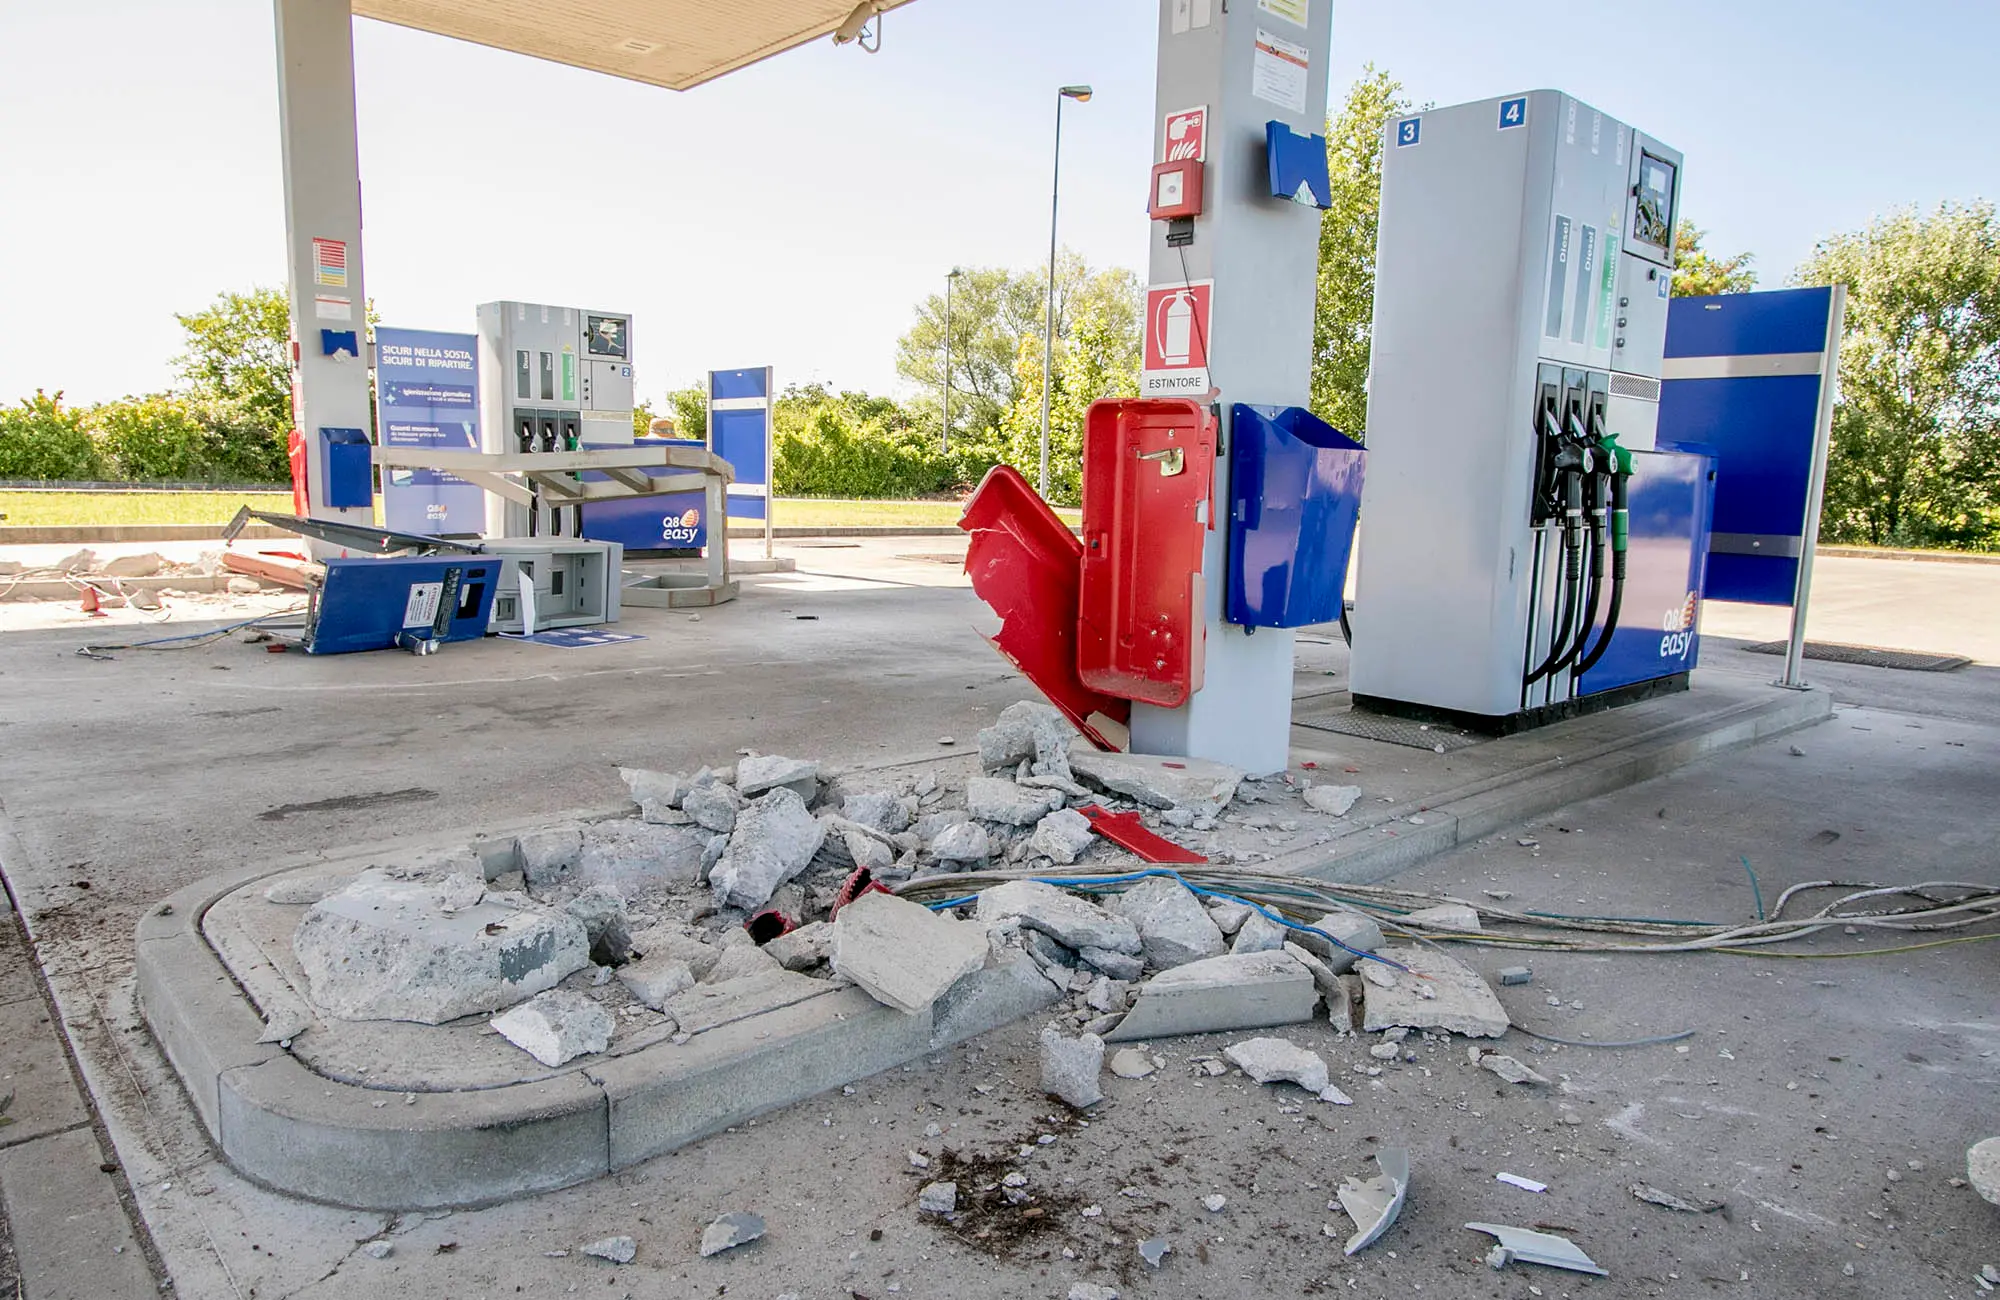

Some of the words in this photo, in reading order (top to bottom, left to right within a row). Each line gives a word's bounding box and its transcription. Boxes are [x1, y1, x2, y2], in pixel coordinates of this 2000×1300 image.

[1505, 103, 1519, 123] 4
[1403, 123, 1415, 142] 3
[1560, 221, 1569, 263] Diesel
[1585, 231, 1594, 272] Diesel
[382, 345, 412, 356] SICURI
[414, 347, 441, 358] NELLA
[444, 350, 473, 361] SOSTA,
[382, 356, 412, 366] SICURI
[416, 358, 425, 367] DI
[428, 359, 473, 370] RIPARTIRE.
[623, 368, 630, 376] 2
[1149, 377, 1201, 389] ESTINTORE
[427, 512, 448, 520] easy
[663, 516, 680, 528] Q8
[663, 528, 698, 543] easy
[1663, 608, 1679, 631] Q8
[1660, 631, 1694, 661] easy
